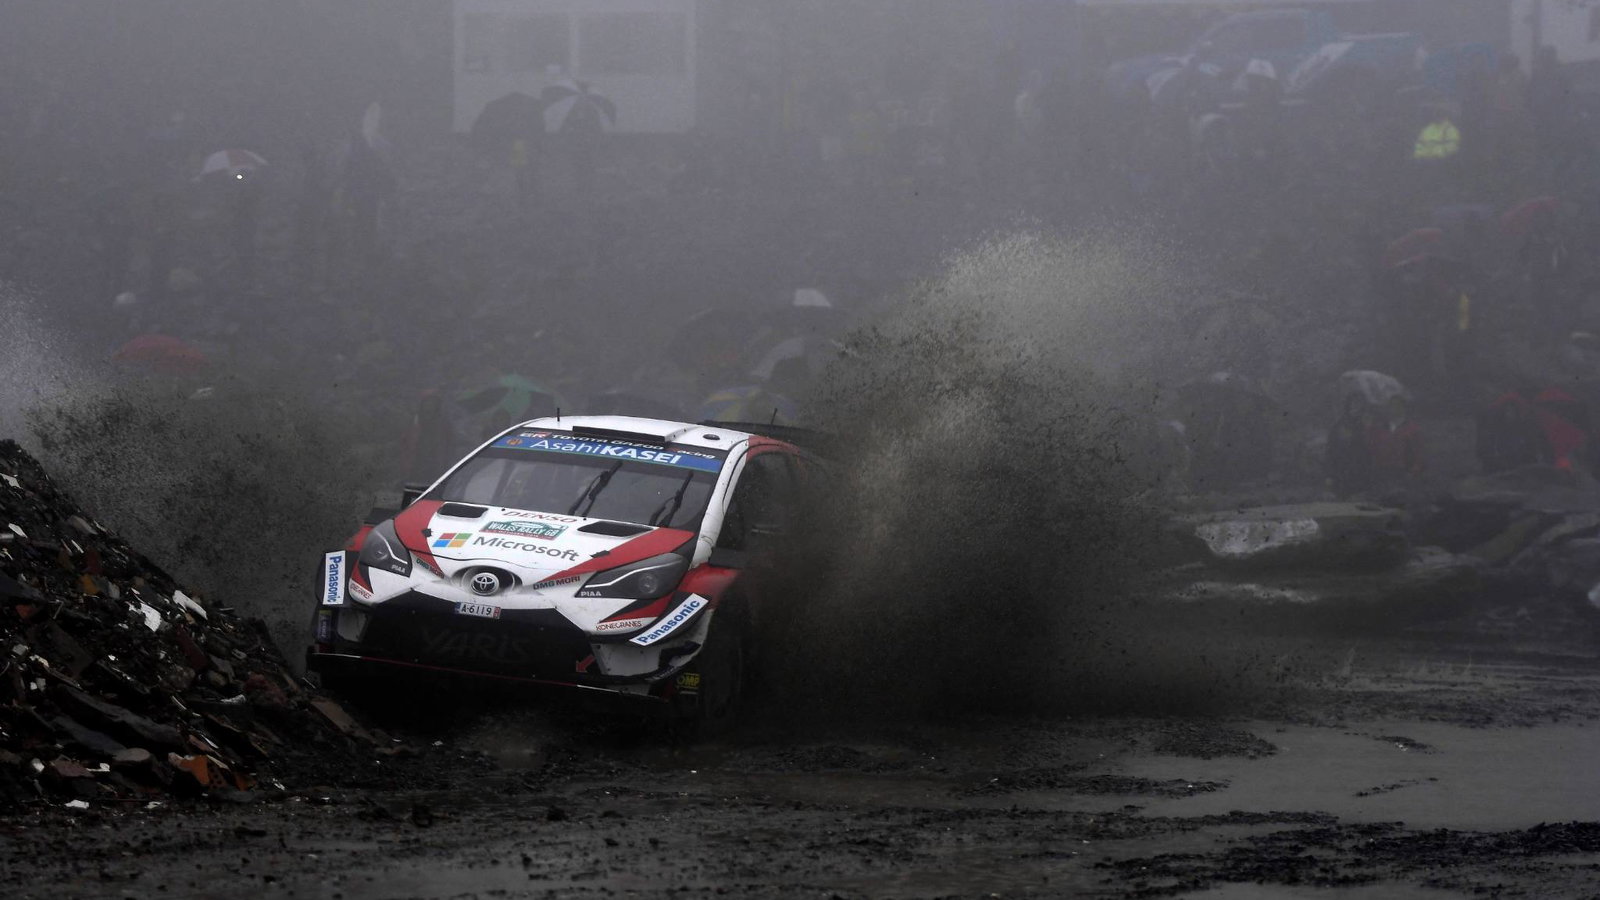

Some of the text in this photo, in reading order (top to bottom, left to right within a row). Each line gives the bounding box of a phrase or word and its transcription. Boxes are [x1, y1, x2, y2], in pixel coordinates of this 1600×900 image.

[552, 434, 608, 444] TOYOTA
[613, 439, 666, 450] GAZOO
[502, 511, 578, 523] DENSO
[488, 522, 518, 532] WALES
[517, 526, 546, 535] RALLY
[544, 529, 560, 537] GB
[472, 536, 581, 562] Microsoft
[327, 555, 343, 603] Panasonic
[532, 575, 581, 590] DMG MORI
[461, 604, 492, 616] A-6119
[595, 619, 643, 632] KONECRANES
[636, 599, 701, 645] Panasonic
[676, 674, 701, 687] OMP
